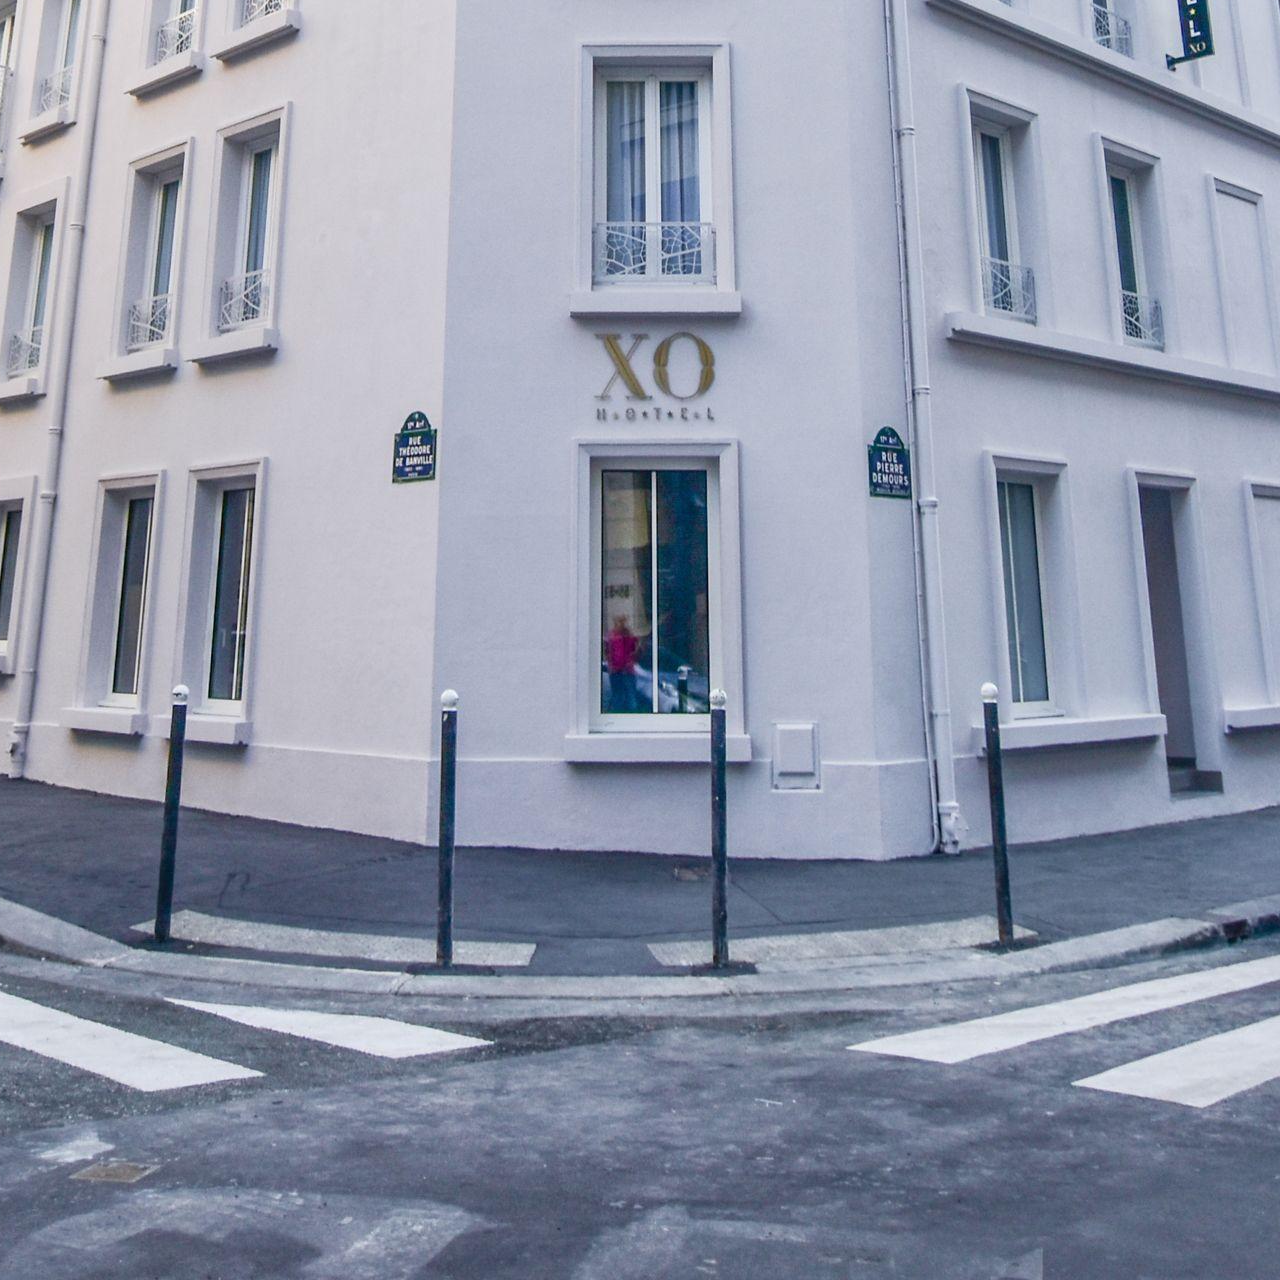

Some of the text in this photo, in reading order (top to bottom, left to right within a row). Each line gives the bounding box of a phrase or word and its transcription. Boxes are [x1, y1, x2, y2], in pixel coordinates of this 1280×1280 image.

[593, 331, 715, 401] XO
[596, 407, 714, 421] HOTEL
[408, 436, 421, 445] RUE
[395, 455, 433, 467] DE BANVILLE
[881, 452, 898, 463] RUE
[876, 462, 904, 474] PIERRE
[872, 473, 909, 486] DEMOURS
